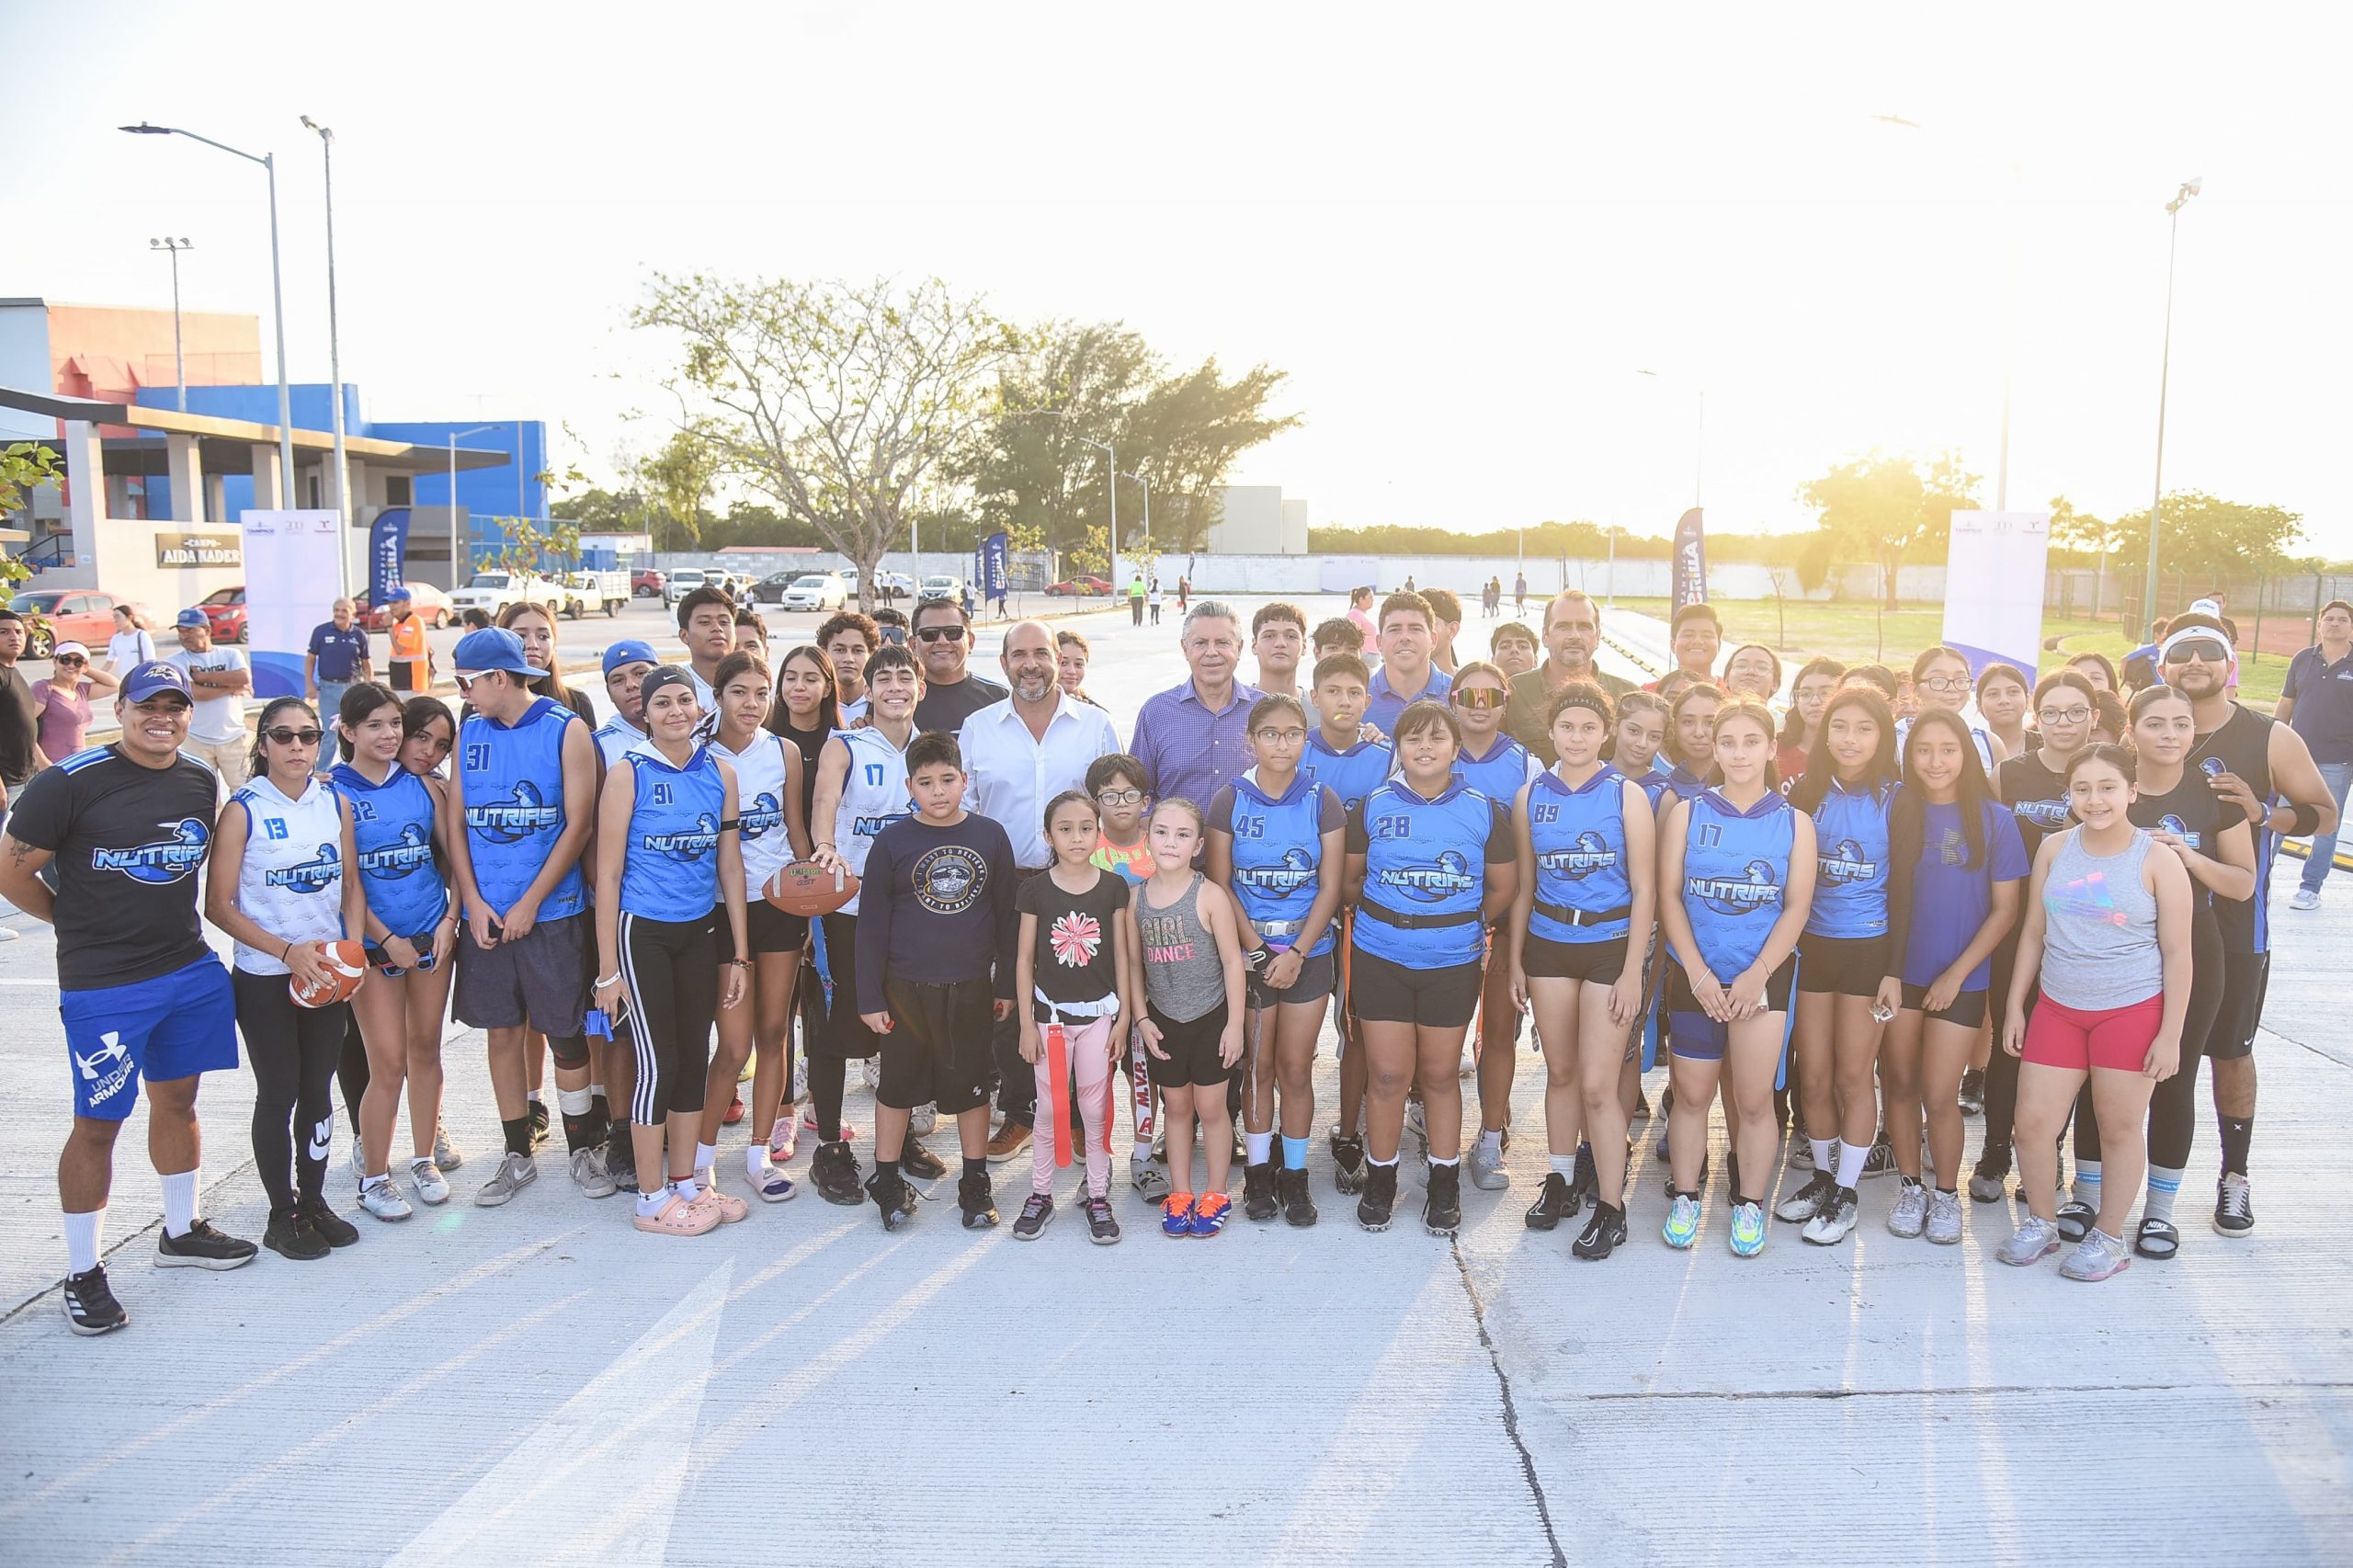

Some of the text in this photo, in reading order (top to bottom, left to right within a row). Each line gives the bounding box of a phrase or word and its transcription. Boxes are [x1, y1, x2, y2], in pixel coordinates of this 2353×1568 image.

[164, 549, 240, 563] AIDA NADER
[466, 743, 491, 771] 31
[865, 764, 884, 786] 17
[653, 782, 674, 805] 91
[1534, 802, 1560, 824] 89
[2015, 801, 2070, 818] NUTRI
[264, 818, 289, 840] 13
[1234, 814, 1266, 839] 45
[1377, 815, 1411, 838] 28
[1699, 823, 1722, 847] 17
[1536, 851, 1617, 869] NUTRIAS
[1379, 869, 1475, 890] NUTRIAS
[1688, 877, 1780, 902] NUTRIAS
[1141, 914, 1194, 946] GIRL
[1147, 943, 1193, 963] DANCE
[91, 1053, 131, 1093] UNDER
[88, 1061, 135, 1108] ARMOUR
[2146, 1221, 2169, 1230] NIKE
